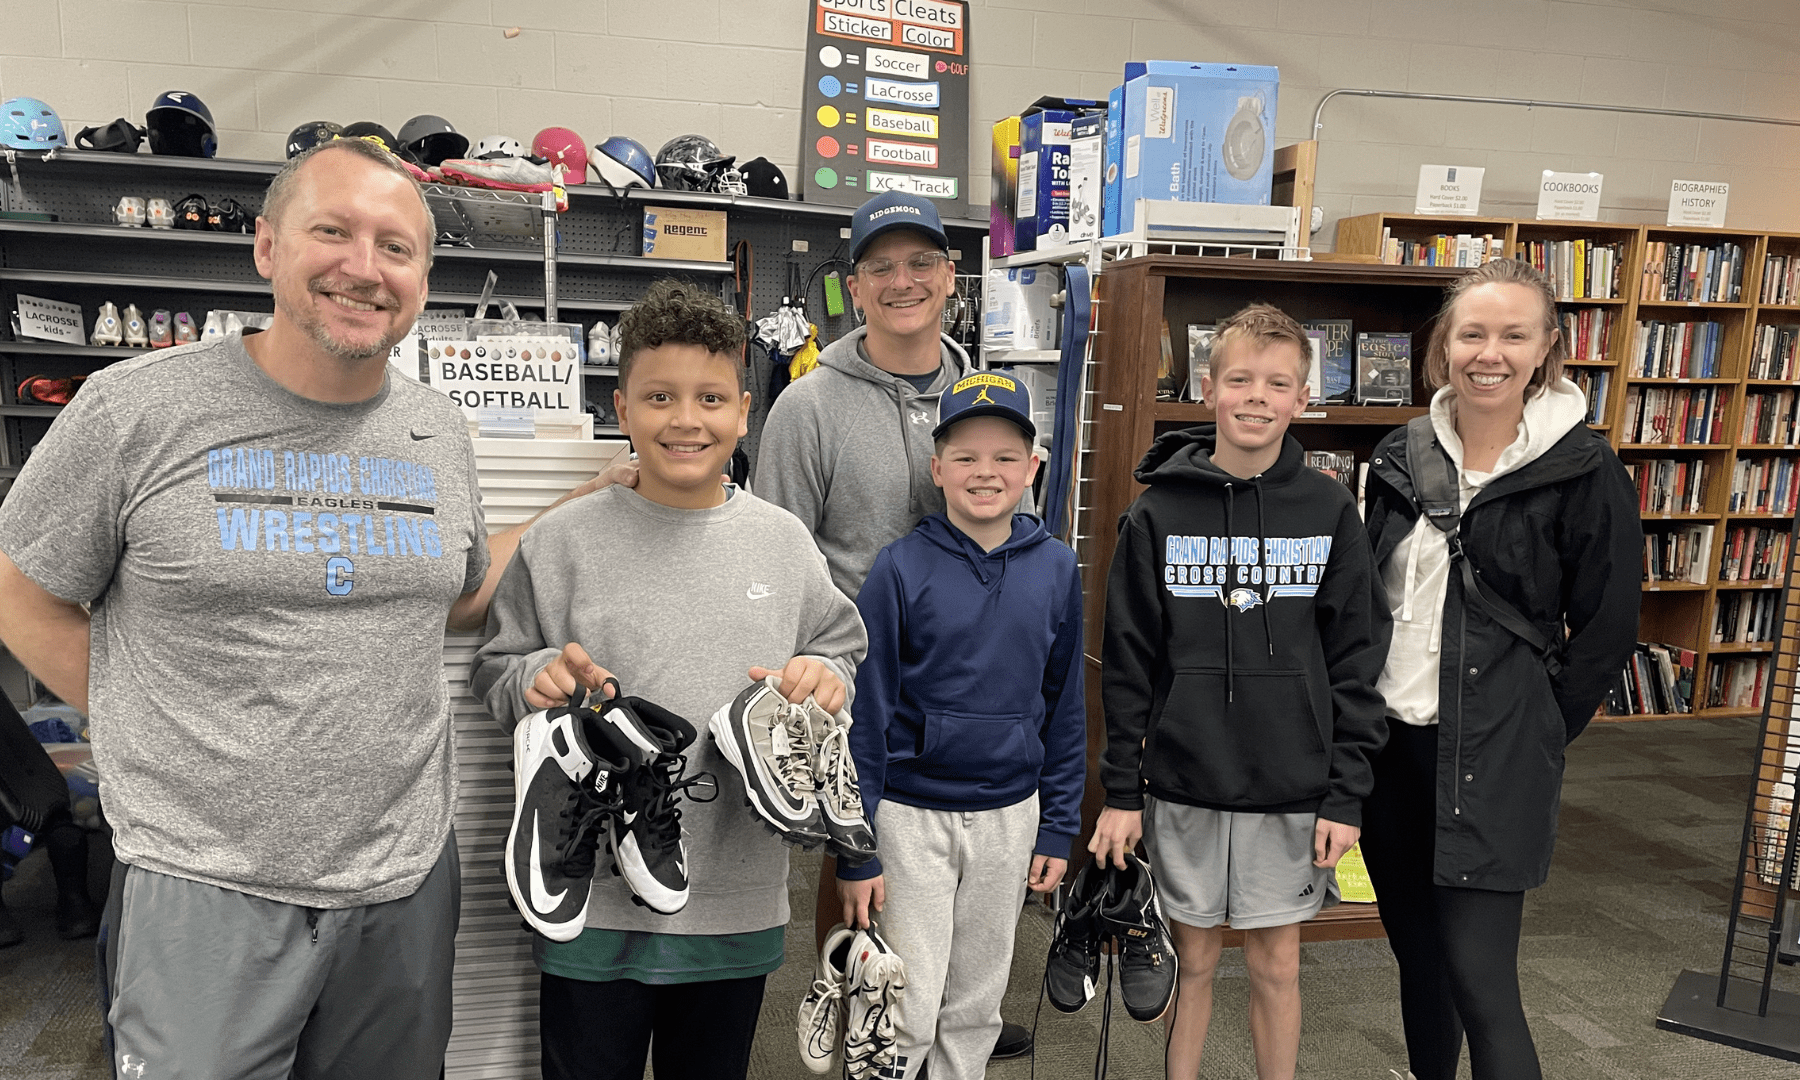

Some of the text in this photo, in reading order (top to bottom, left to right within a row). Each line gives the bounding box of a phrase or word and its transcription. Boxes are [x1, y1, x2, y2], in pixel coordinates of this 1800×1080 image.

[822, 0, 956, 25] ports Cleats
[828, 15, 888, 37] Sticker
[905, 28, 950, 47] Color
[875, 55, 921, 72] Soccer
[872, 84, 933, 101] LaCrosse
[1150, 98, 1160, 122] Well
[1159, 91, 1168, 134] Walgreens
[872, 115, 930, 132] Baseball
[873, 145, 931, 162] Football
[1052, 152, 1070, 165] Ra
[1051, 166, 1071, 179] Toi
[1169, 162, 1181, 192] Bath
[875, 177, 894, 189] XC
[912, 179, 950, 194] Track
[1543, 182, 1599, 194] COOKBOOKS
[1673, 182, 1727, 194] BIOGRAPHIES
[1682, 198, 1716, 208] HISTORY
[870, 206, 921, 221] RIDGEMOOR
[664, 224, 707, 236] Regent
[26, 311, 79, 328] LACROSSE
[44, 324, 64, 336] kids
[418, 324, 463, 333] ACROSSE
[442, 362, 573, 385] BASEBALL/
[956, 374, 1014, 390] MICHIGAN
[449, 389, 570, 410] SOFTBALL
[208, 448, 437, 502] GRAND RAPIDS CHRISTIAN
[297, 496, 374, 510] EAGLES
[216, 508, 443, 558] WRESTLING
[1166, 535, 1333, 566] GRAND RAPIDS CHRISTIAN
[326, 556, 355, 596] C
[1165, 566, 1227, 584] CROSS
[750, 581, 770, 594] NIKE
[596, 772, 606, 790] NIKE
